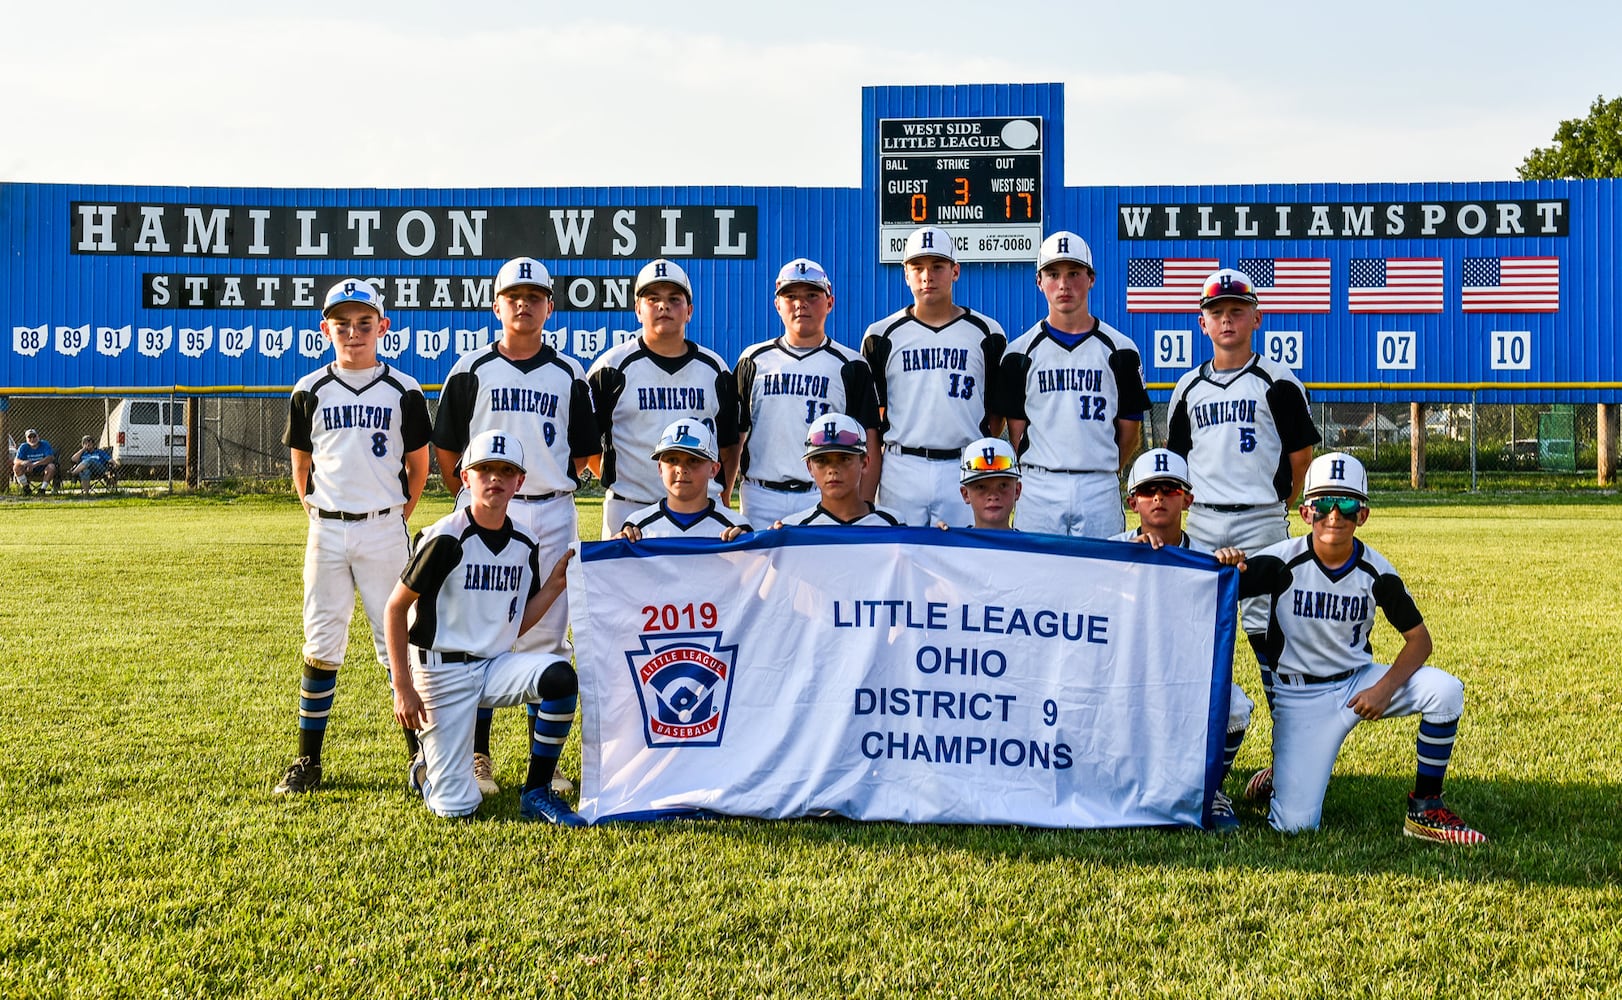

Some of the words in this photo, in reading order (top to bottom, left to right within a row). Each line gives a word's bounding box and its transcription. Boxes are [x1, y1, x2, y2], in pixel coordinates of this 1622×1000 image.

[884, 137, 936, 149] LITTLE
[939, 135, 1000, 148] LEAGUE
[903, 124, 943, 135] WEST
[946, 123, 982, 135] SIDE
[885, 160, 908, 171] BALL
[936, 159, 970, 170] STRIKE
[995, 158, 1015, 169] OUT
[888, 180, 928, 194] GUEST
[954, 177, 969, 205] 3
[991, 179, 1015, 192] WEST
[1016, 178, 1035, 192] SIDE
[911, 194, 927, 221] 0
[938, 206, 983, 220] INNING
[1005, 192, 1032, 219] 17
[77, 206, 488, 257] HAMILTON
[549, 209, 747, 257] WSLL
[1120, 202, 1563, 237] WILLIAMSPORT
[921, 232, 934, 248] H
[979, 238, 1032, 251] 867-0080
[1057, 238, 1069, 254] H
[519, 263, 532, 279] H
[655, 263, 667, 278] H
[1220, 275, 1232, 290] H
[152, 275, 315, 307] STATE
[366, 277, 631, 309] CHAMON
[20, 331, 40, 349] 88
[63, 330, 82, 348] 89
[104, 331, 122, 349] 91
[146, 332, 164, 350] 93
[186, 333, 205, 351] 95
[226, 333, 244, 351] 02
[265, 333, 284, 351] 04
[305, 333, 323, 351] 06
[383, 333, 400, 351] 09
[424, 333, 441, 351] 10
[463, 333, 478, 351] 11
[580, 333, 597, 351] 15
[1160, 334, 1186, 363] 91
[1270, 336, 1298, 364] 93
[1382, 336, 1411, 364] 07
[1497, 336, 1525, 364] 10
[902, 347, 969, 373] HAMILTON
[763, 373, 829, 399] HAMILTON
[948, 373, 976, 400] 13
[1037, 368, 1103, 394] HAMILTON
[491, 387, 559, 418] HAMILTON
[638, 387, 705, 411] HAMILTON
[1080, 395, 1107, 422] 12
[322, 404, 393, 431] HAMILTON
[1194, 398, 1257, 429] HAMILTON
[371, 432, 388, 458] 8
[491, 435, 506, 455] H
[1238, 427, 1258, 454] 5
[1154, 453, 1169, 472] H
[1329, 460, 1345, 480] H
[641, 602, 718, 632] 2019
[1293, 589, 1369, 623] HAMILTON
[834, 600, 948, 630] LITTLE
[961, 604, 1109, 645] LEAGUE
[643, 651, 677, 677] LITTLE
[683, 650, 724, 673] LEAGUE
[916, 646, 1007, 678] OHIO
[854, 687, 1017, 722] DISTRICT
[1042, 699, 1058, 726] 9
[656, 721, 714, 738] BASEBALL
[861, 731, 1073, 770] CHAMPIONS
